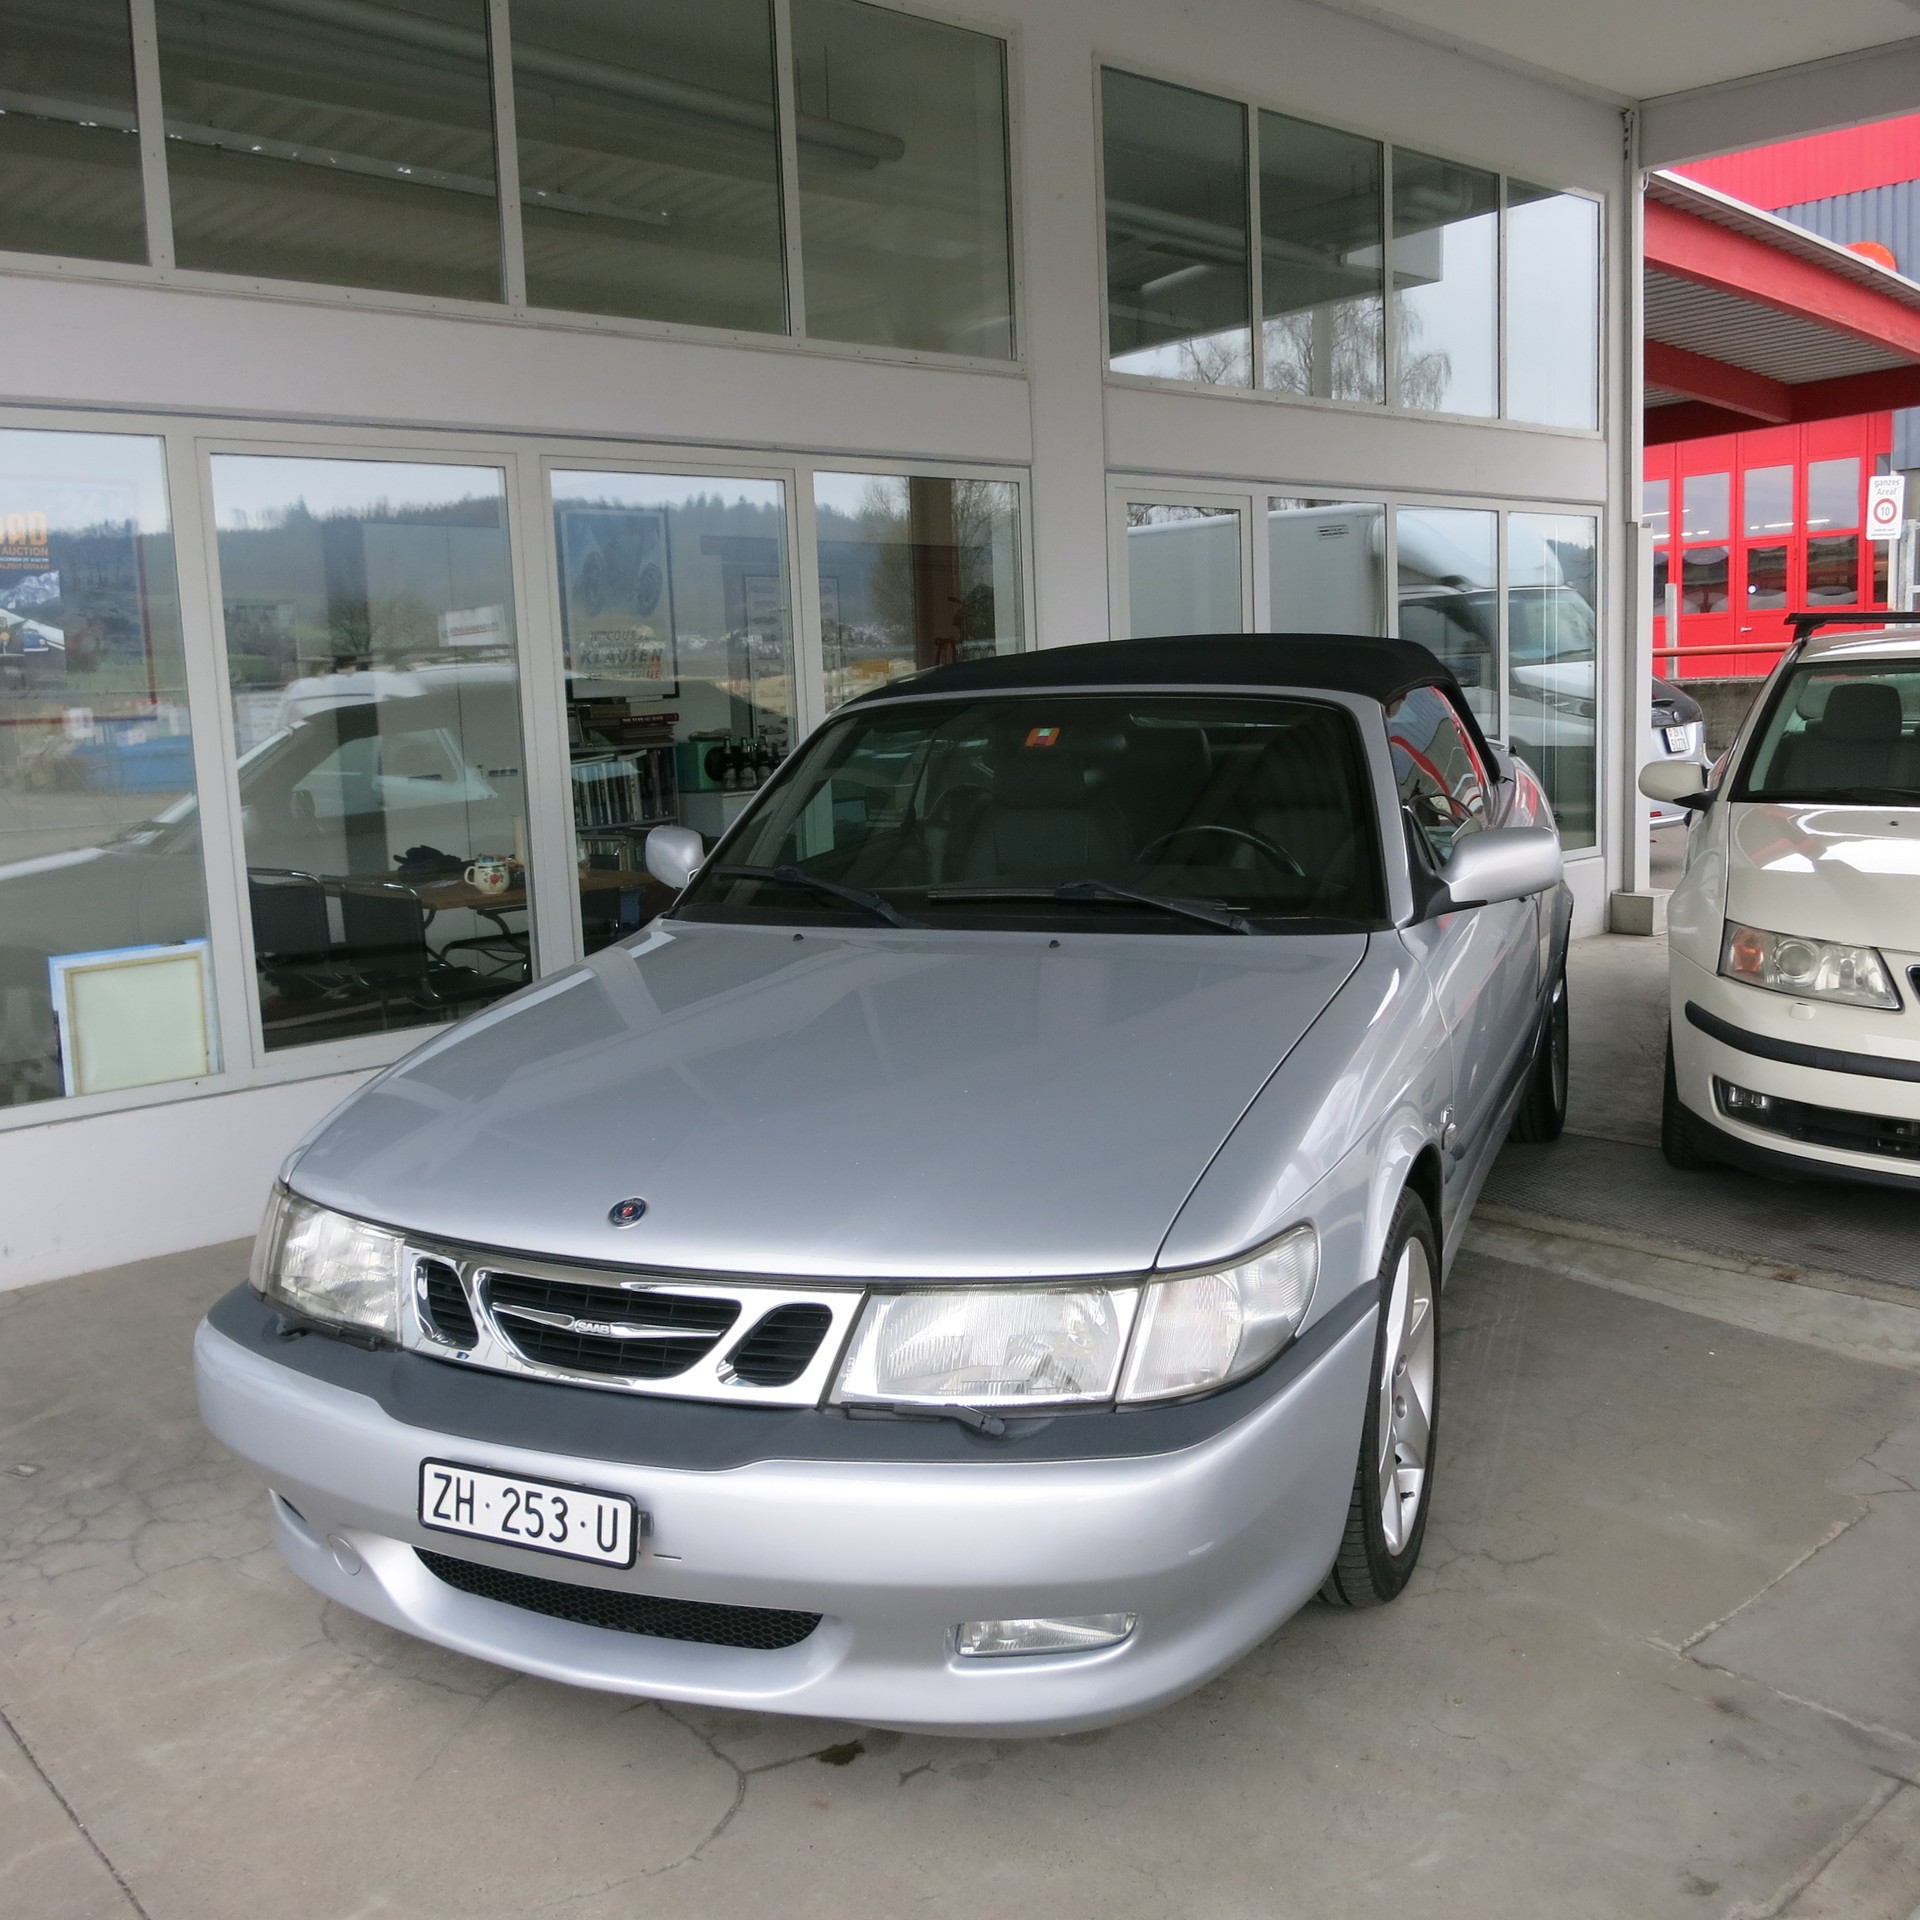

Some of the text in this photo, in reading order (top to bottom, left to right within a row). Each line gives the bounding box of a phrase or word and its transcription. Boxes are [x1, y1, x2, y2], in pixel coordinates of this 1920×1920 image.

[1874, 480, 1900, 488] ganzes
[1880, 506, 1891, 517] 10
[0, 511, 48, 545] AD
[2, 546, 48, 556] AUCTION
[581, 648, 663, 664] KLAUSEN
[578, 1321, 610, 1335] SAAB
